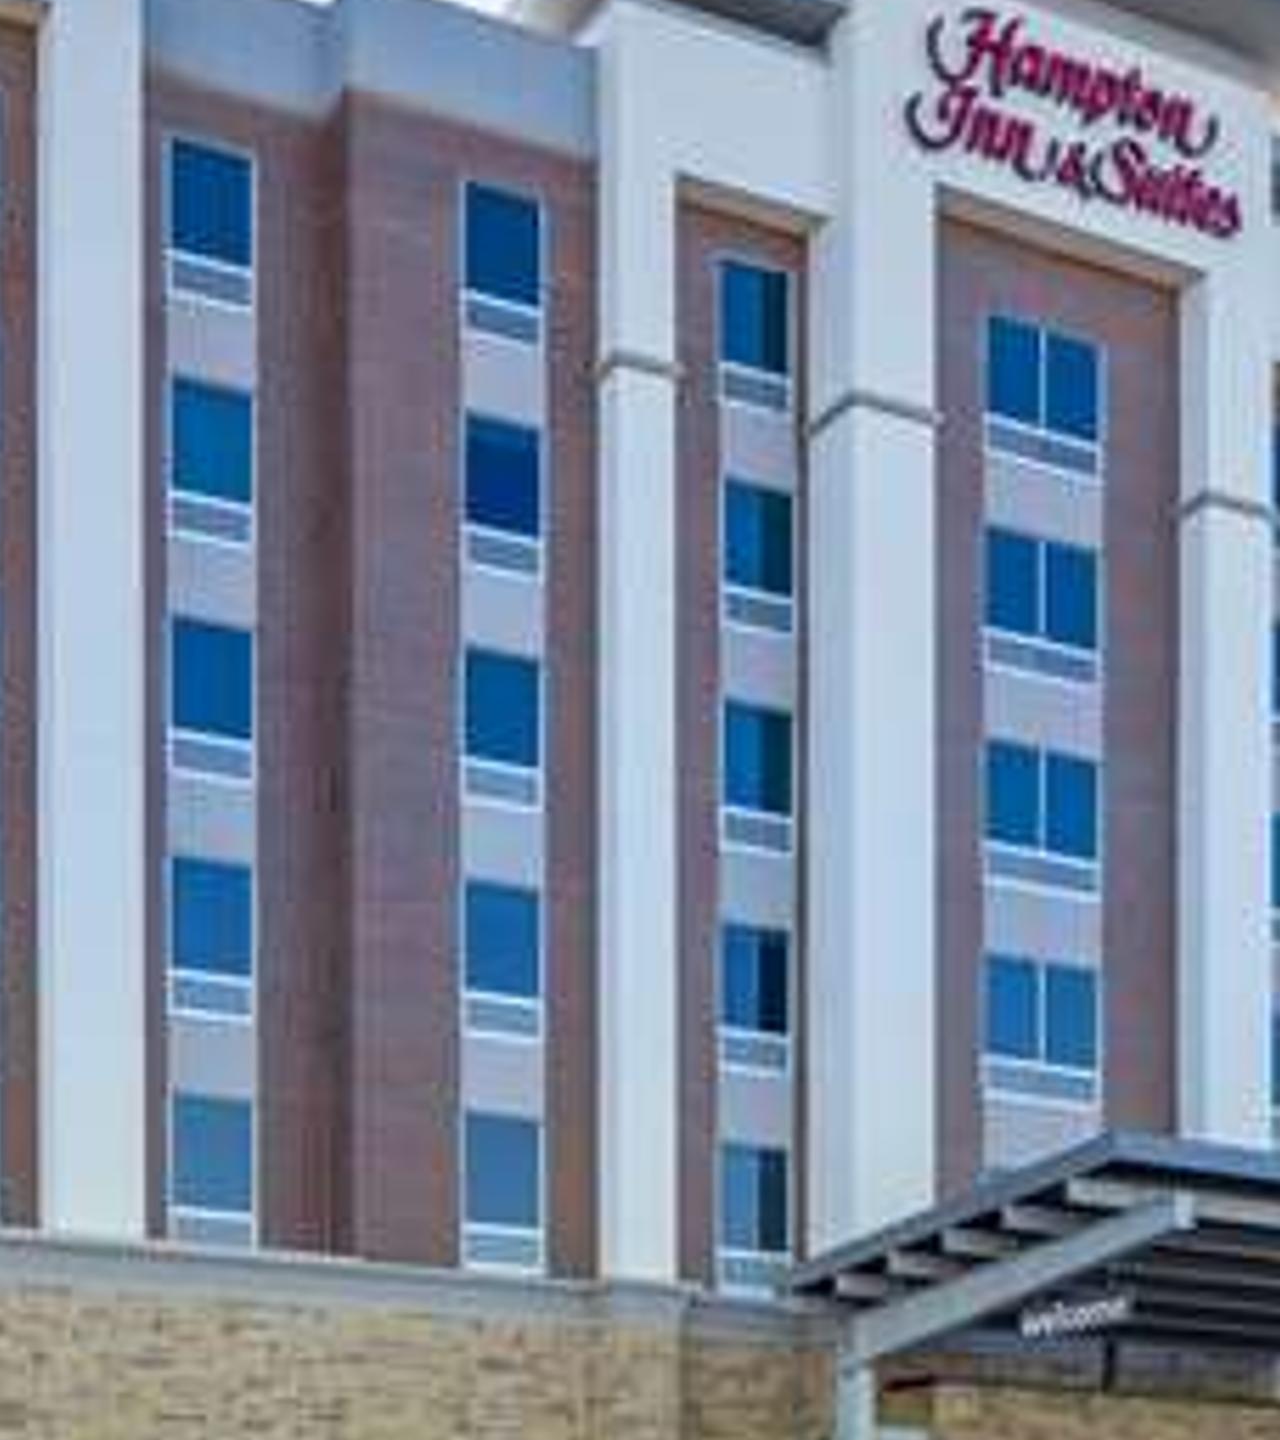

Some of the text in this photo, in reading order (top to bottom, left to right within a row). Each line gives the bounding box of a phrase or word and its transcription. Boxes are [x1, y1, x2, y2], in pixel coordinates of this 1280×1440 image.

[927, 8, 1218, 157] Hampton
[904, 84, 1243, 238] Inn & Suites
